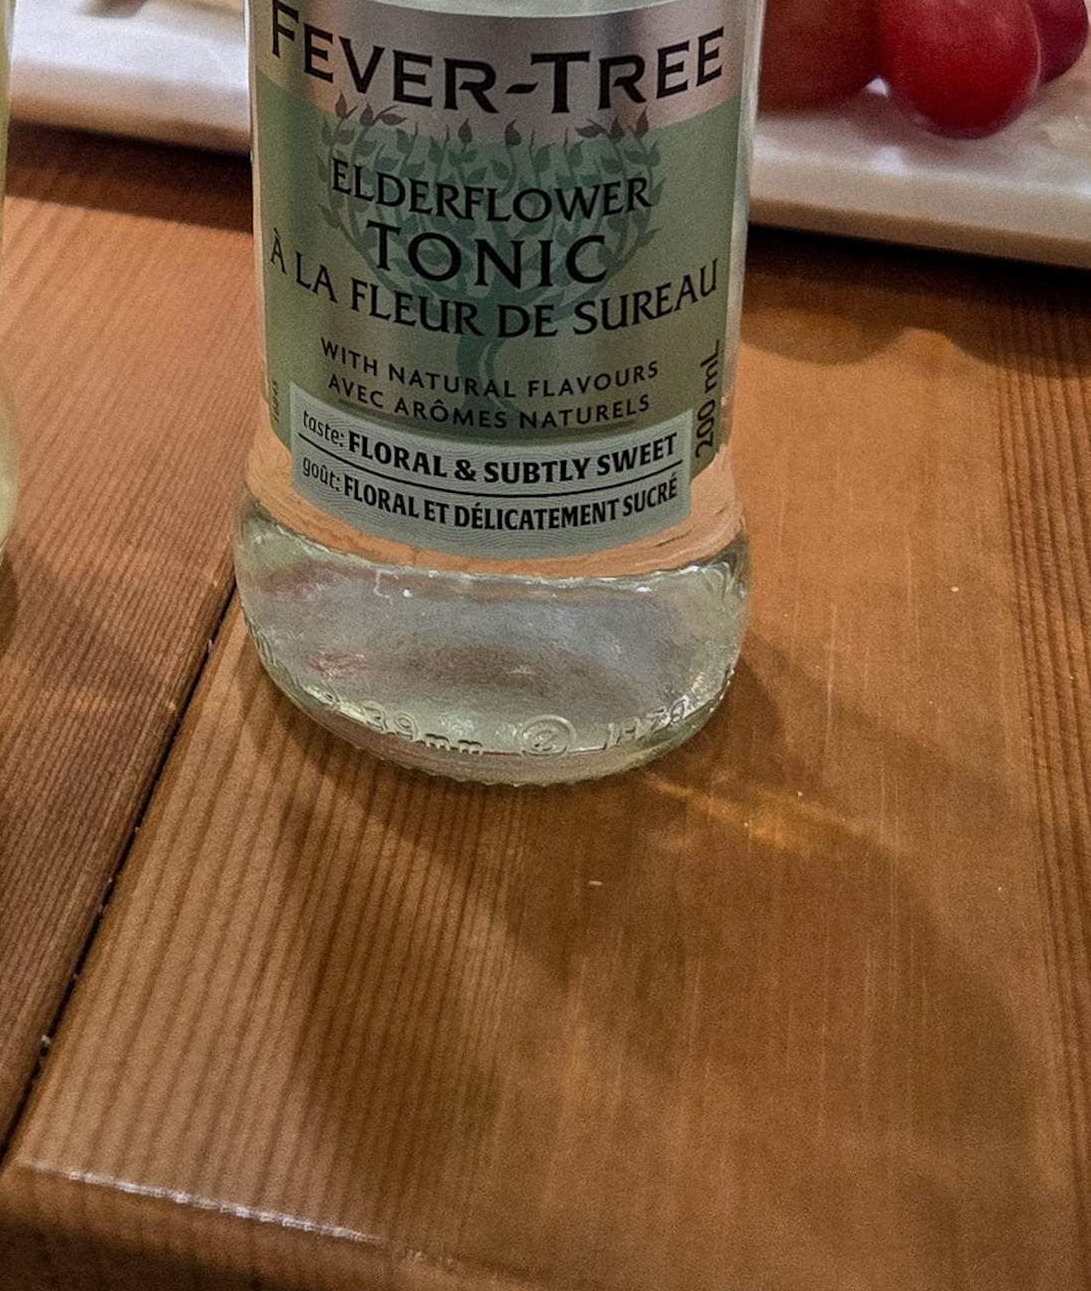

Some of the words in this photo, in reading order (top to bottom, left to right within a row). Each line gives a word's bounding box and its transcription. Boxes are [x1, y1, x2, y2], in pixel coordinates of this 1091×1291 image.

[332, 157, 653, 222] ELDERFLOWER
[270, 226, 287, 275] À
[295, 250, 338, 304] LA
[351, 277, 483, 336] FLEUR
[498, 303, 559, 338] DE
[573, 257, 719, 336] SUREAU
[366, 220, 608, 289] TONIC
[320, 337, 378, 376] WITH
[388, 363, 517, 398] NATURAL
[528, 360, 659, 398] FLAVOURS
[699, 339, 720, 394] mL
[328, 374, 384, 409] AVEC
[394, 399, 507, 429] ARÔMES
[519, 394, 650, 429] NATURELS
[695, 399, 716, 458] 200
[303, 410, 345, 448] taste:
[348, 429, 447, 478] FLORAL
[454, 458, 476, 482] &
[484, 457, 591, 484] SUBTLY
[596, 432, 678, 476] SWEET
[302, 456, 340, 492] goût:
[344, 474, 419, 519] FLORAL
[423, 499, 449, 525] ET
[454, 498, 620, 531] DÉLICATEMENT
[622, 471, 678, 518] SUCRÉ
